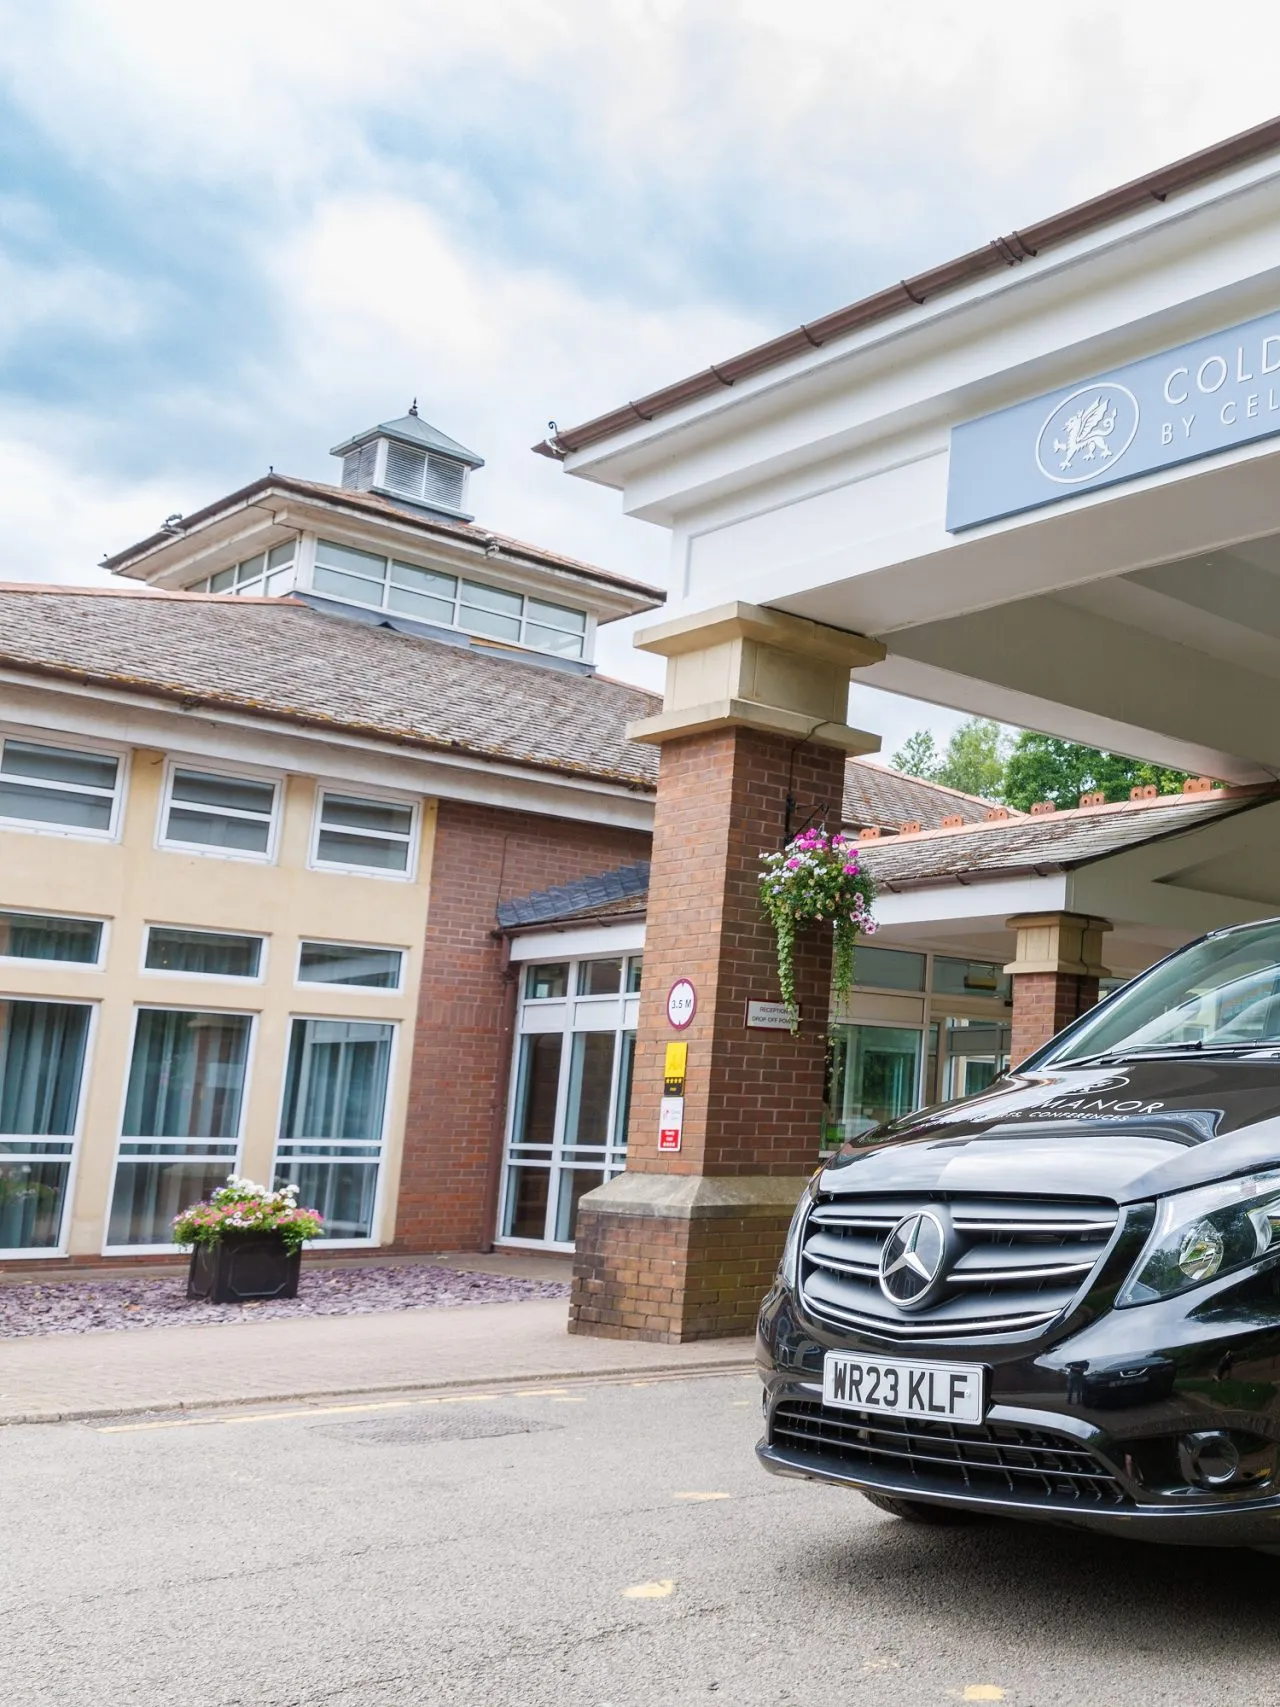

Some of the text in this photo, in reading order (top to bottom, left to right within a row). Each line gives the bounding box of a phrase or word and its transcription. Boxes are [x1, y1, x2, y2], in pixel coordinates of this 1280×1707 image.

[1161, 414, 1196, 445] BY
[671, 998, 692, 1009] 3.5 M
[751, 1015, 766, 1023] DROP
[1033, 1098, 1165, 1113] MANOR
[1029, 1110, 1130, 1122] CONFERENCES
[833, 1361, 968, 1414] WR23 KLF
